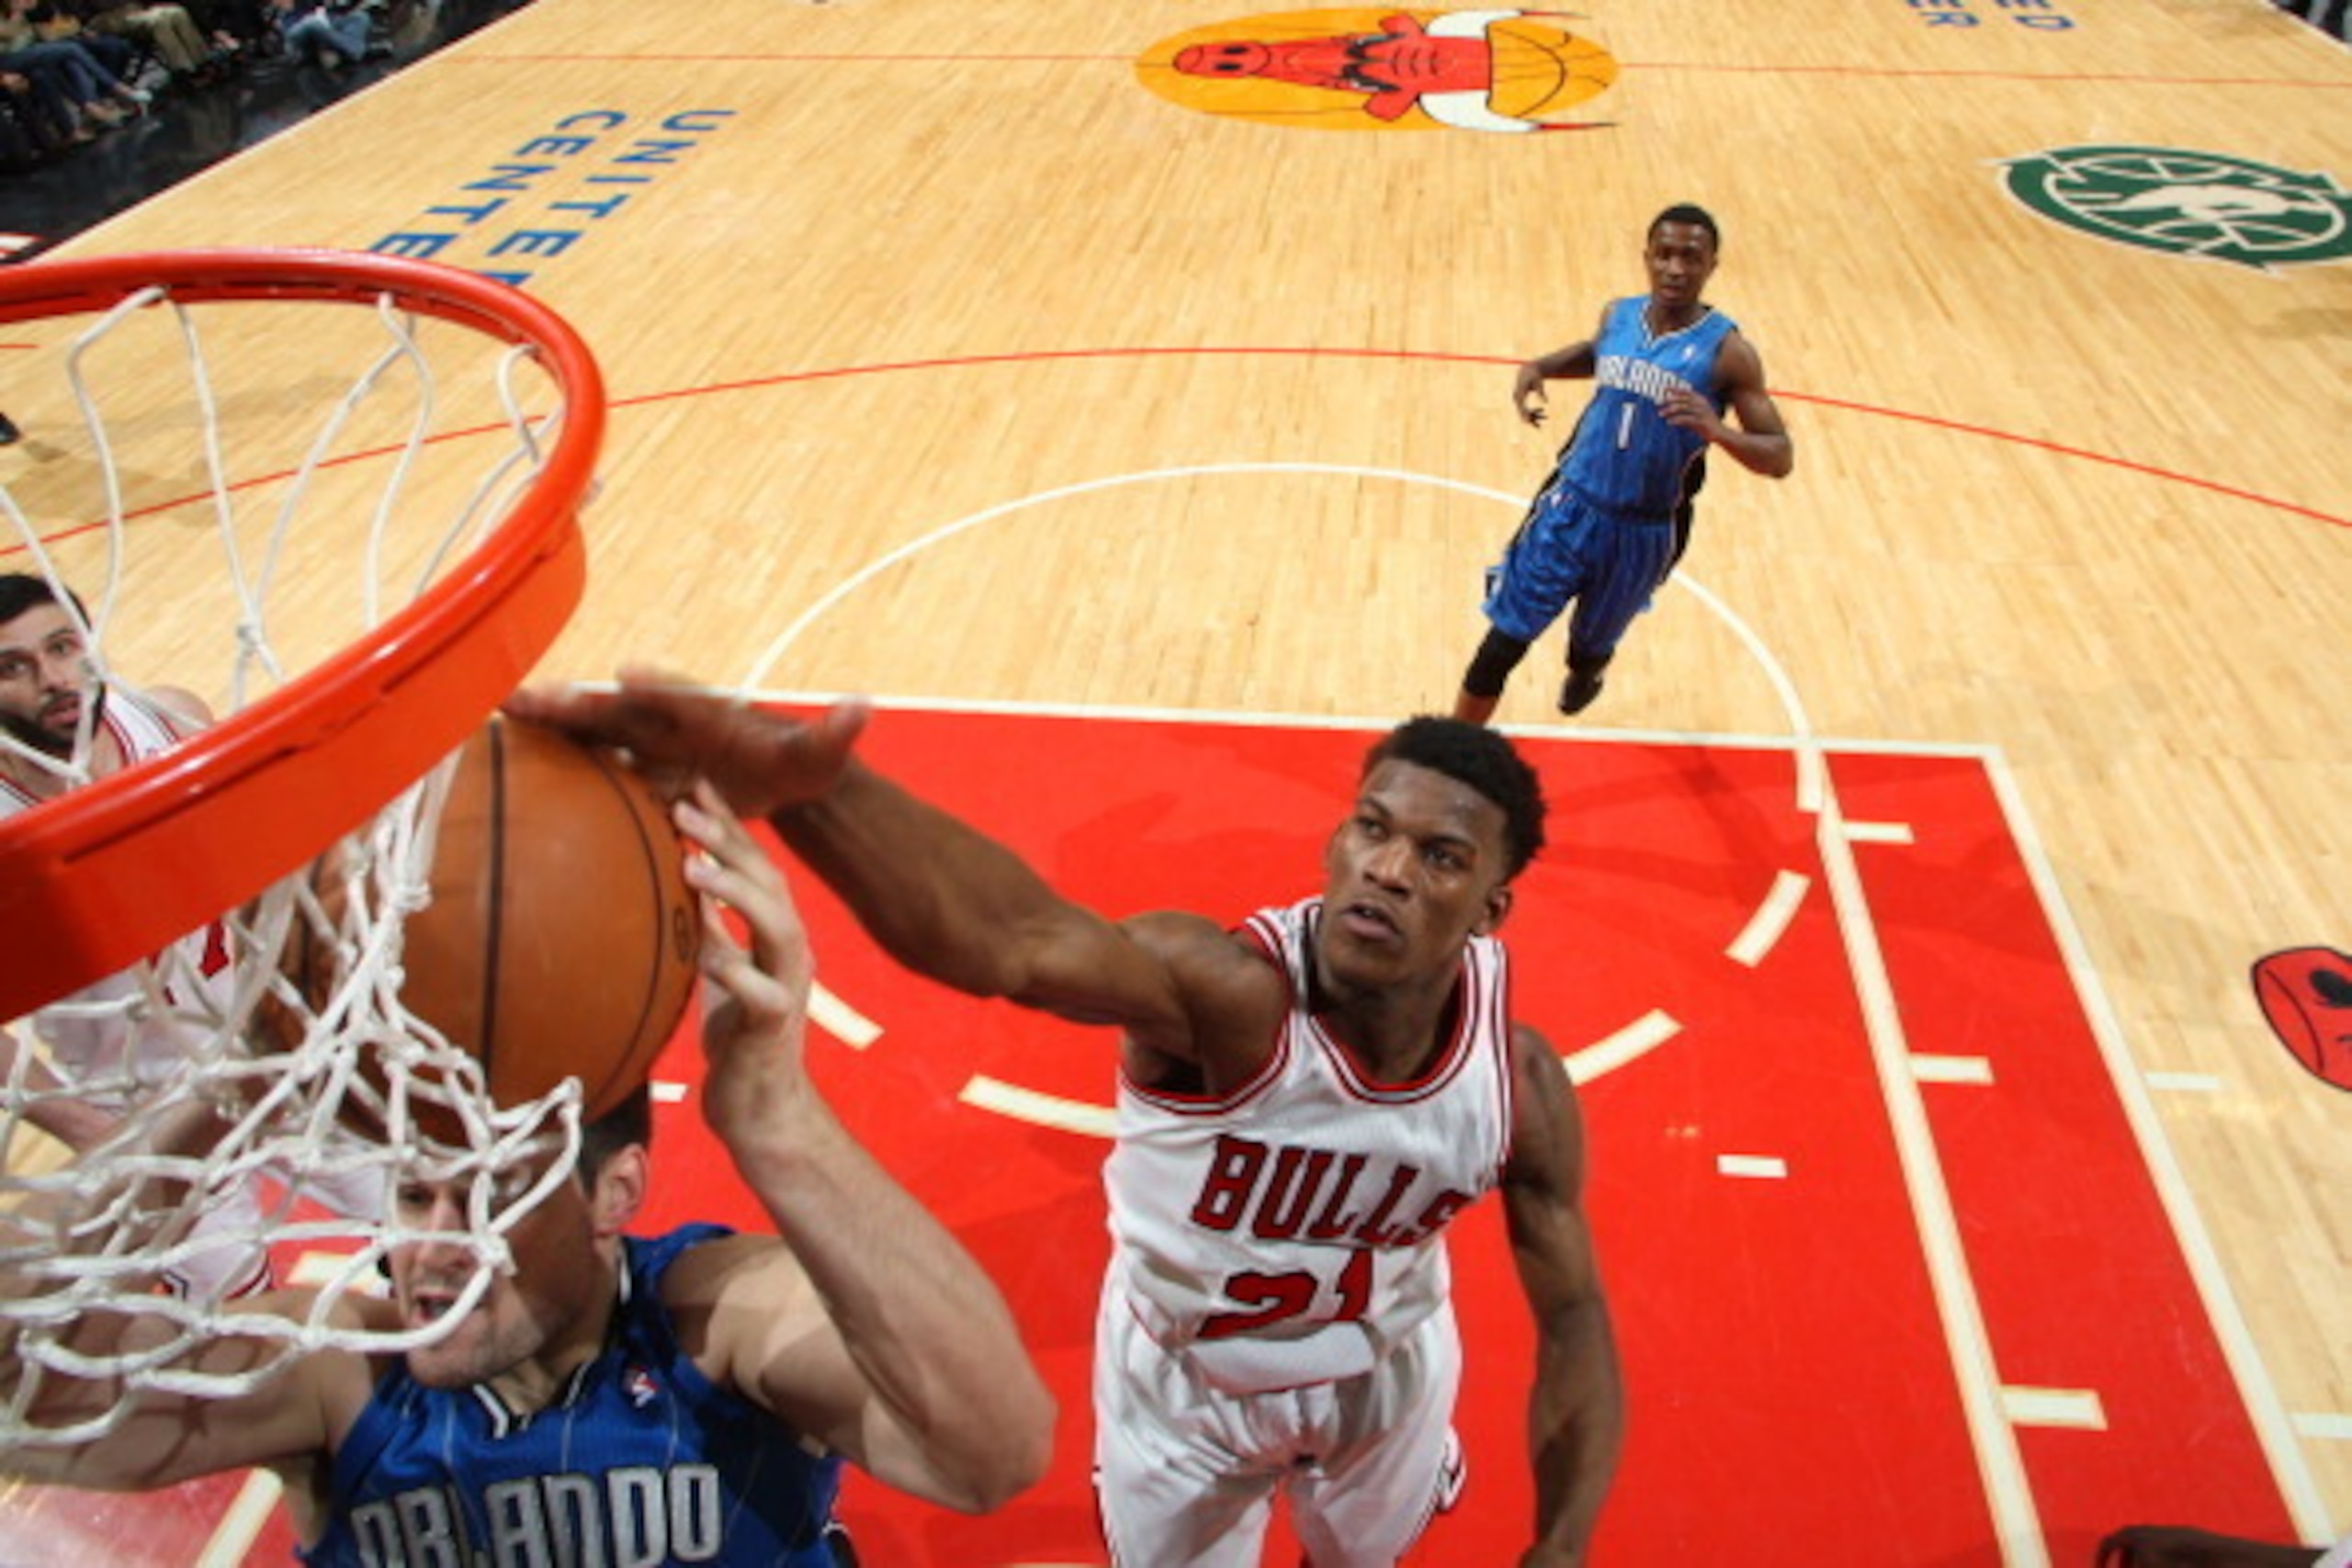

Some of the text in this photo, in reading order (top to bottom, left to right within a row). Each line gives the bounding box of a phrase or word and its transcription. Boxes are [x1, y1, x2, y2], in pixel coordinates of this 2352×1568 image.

[367, 109, 628, 258] CENTE
[1617, 400, 1636, 449] 1
[1188, 1133, 1476, 1247] BULLS
[1195, 1247, 1374, 1341] 21
[350, 1463, 722, 1568] ORLANDO
